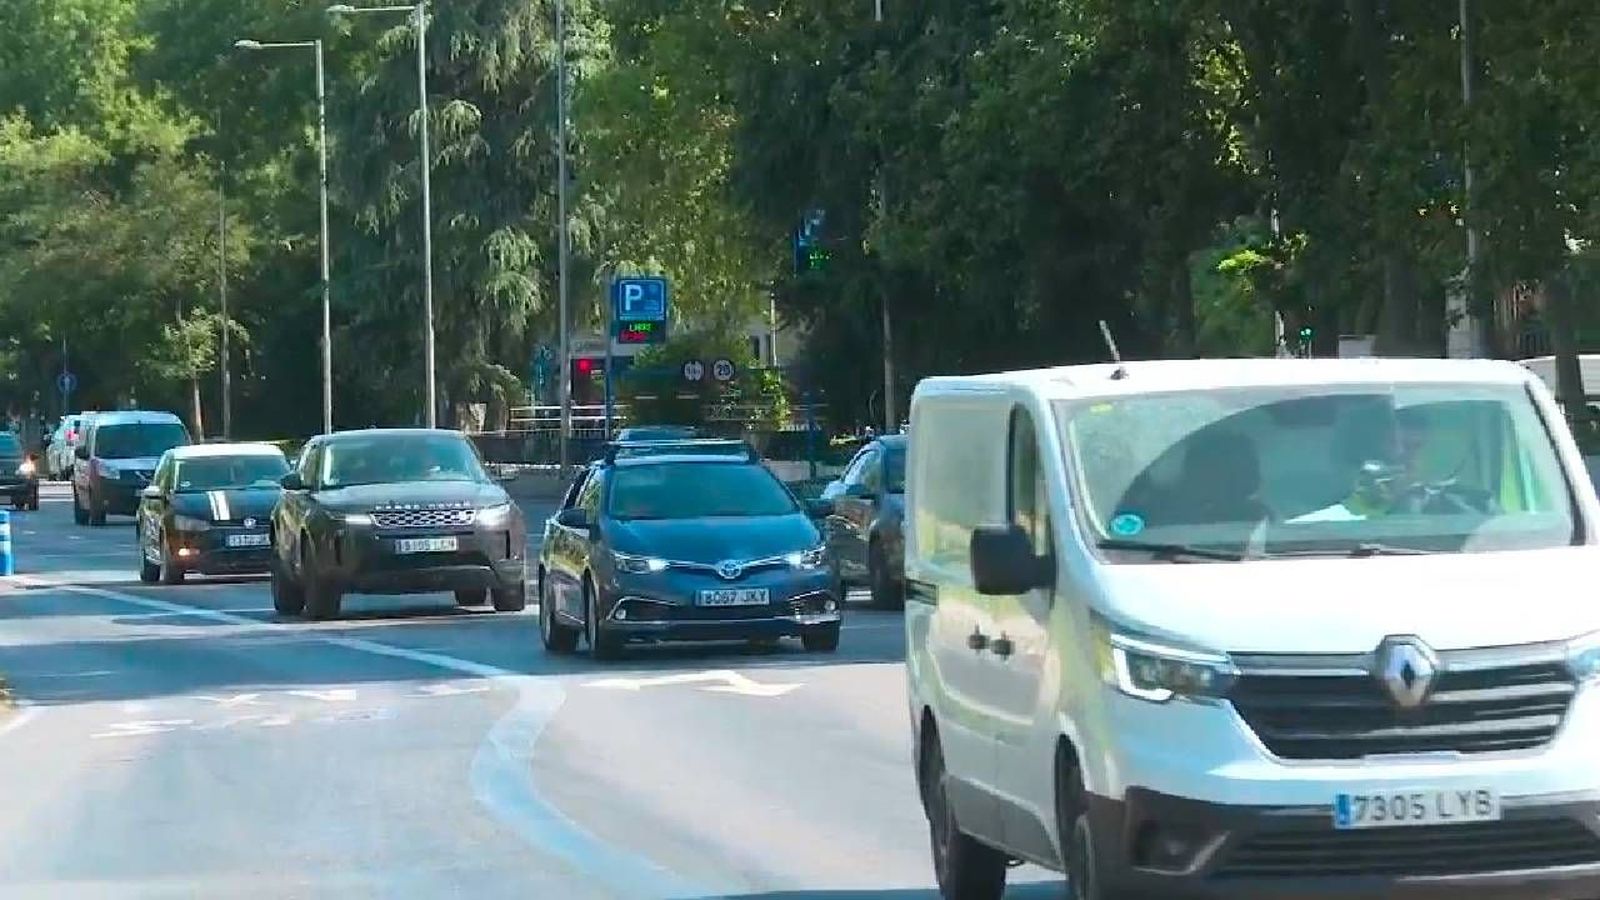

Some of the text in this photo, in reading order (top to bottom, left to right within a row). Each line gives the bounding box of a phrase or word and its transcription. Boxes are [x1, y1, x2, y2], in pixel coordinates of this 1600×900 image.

[625, 285, 642, 310] P
[1354, 789, 1492, 822] 7305 LYB
